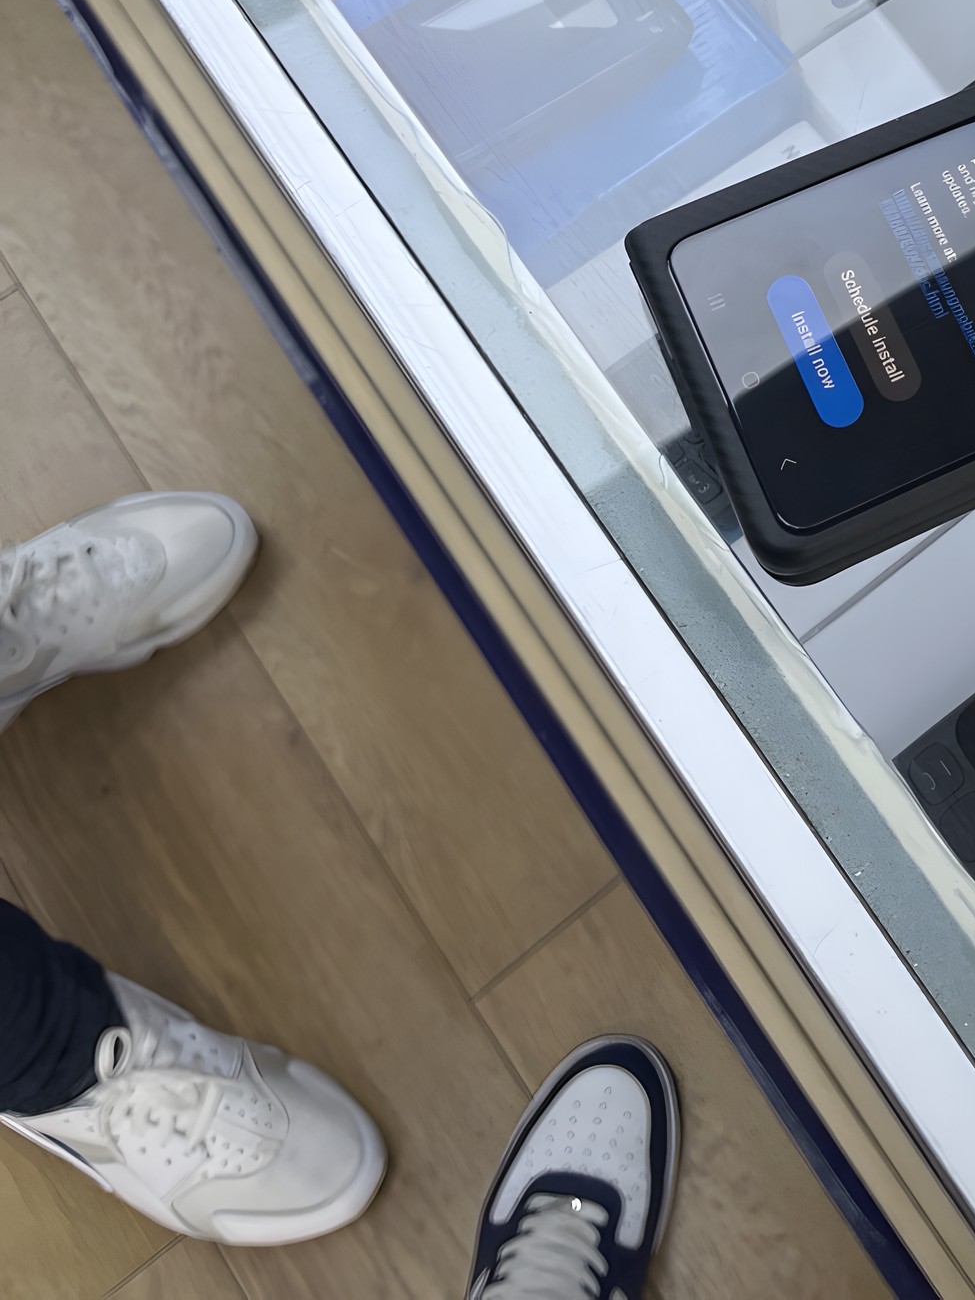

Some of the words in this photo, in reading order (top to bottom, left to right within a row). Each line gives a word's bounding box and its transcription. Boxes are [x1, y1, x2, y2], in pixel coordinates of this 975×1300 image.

[909, 181, 934, 215] Learn
[926, 214, 949, 246] more
[791, 310, 823, 356] Install
[812, 358, 836, 389] now
[840, 269, 879, 336] Schedule
[872, 336, 906, 383] install
